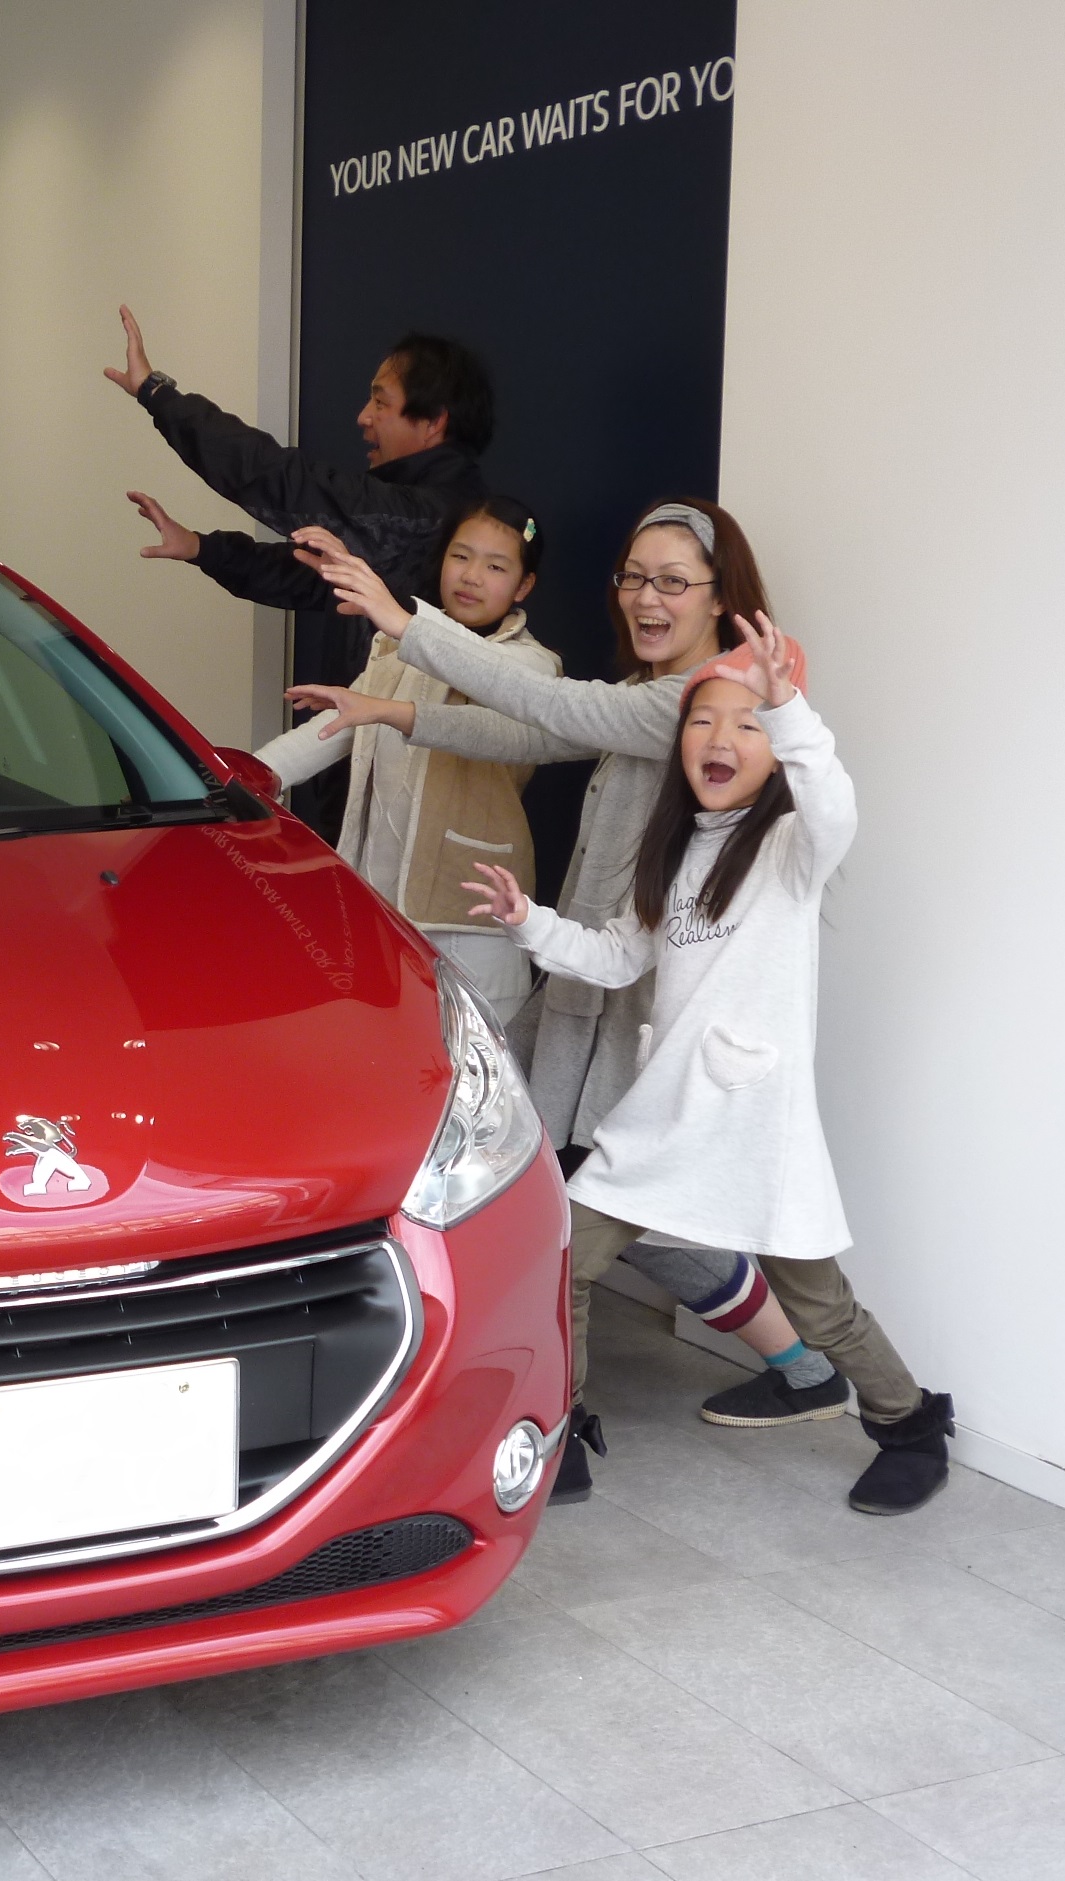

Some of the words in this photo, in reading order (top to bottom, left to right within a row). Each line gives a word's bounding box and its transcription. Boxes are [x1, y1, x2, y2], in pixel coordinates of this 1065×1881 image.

[330, 149, 392, 197] YOUR
[397, 130, 458, 181] NEW
[462, 116, 515, 164] CAR
[521, 89, 610, 149] WAITS
[618, 71, 682, 126] FOR
[689, 56, 735, 107] YO
